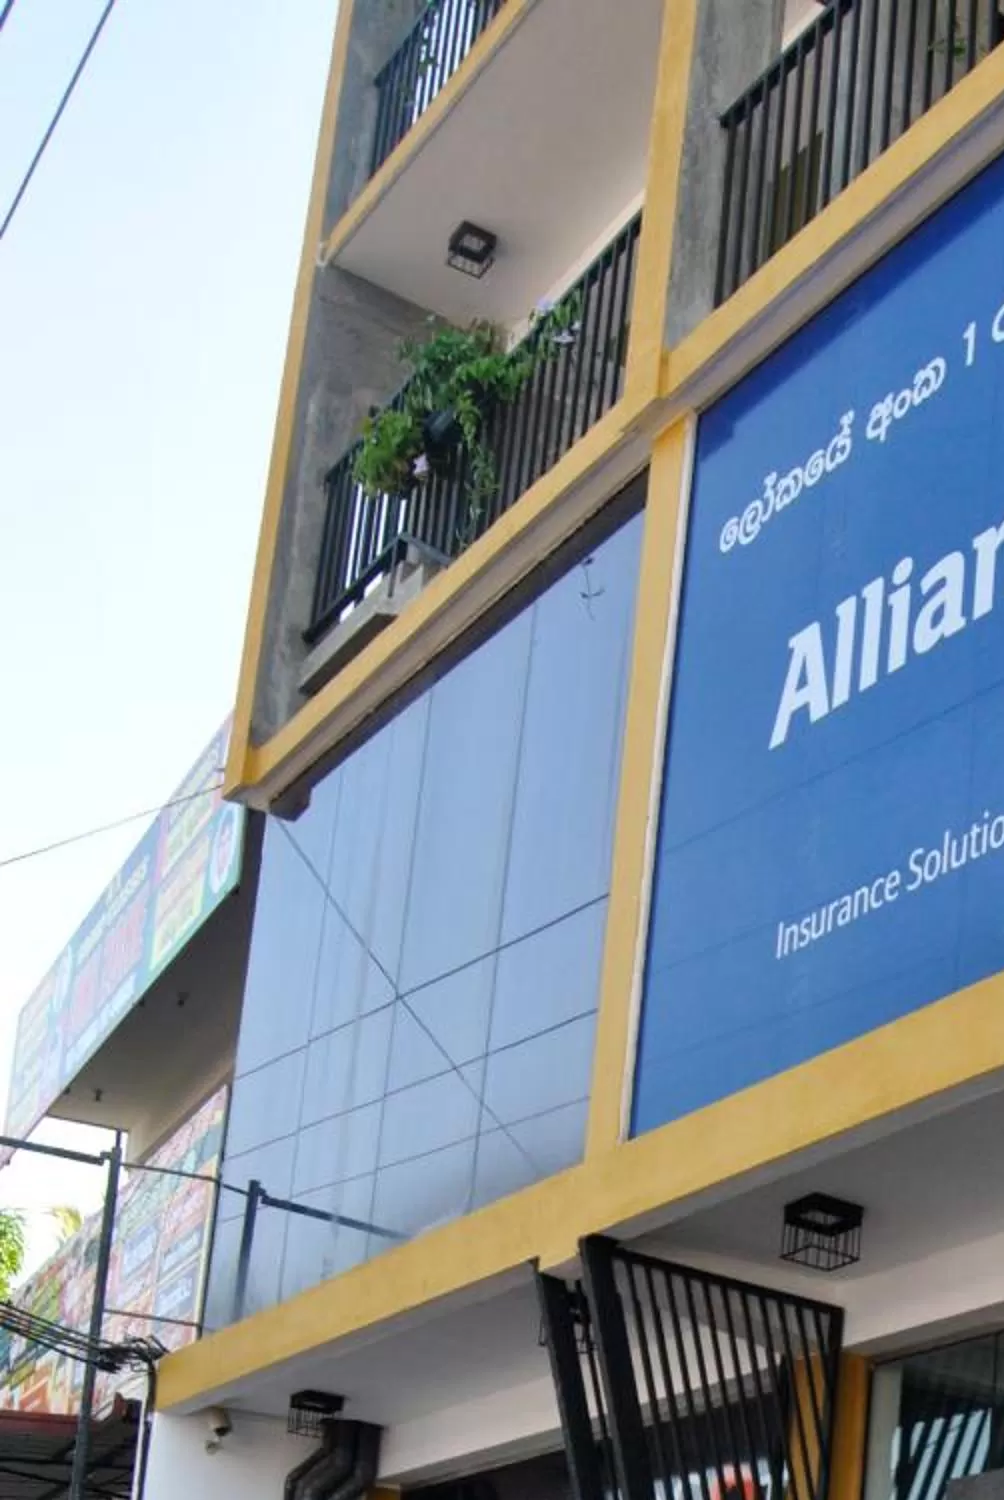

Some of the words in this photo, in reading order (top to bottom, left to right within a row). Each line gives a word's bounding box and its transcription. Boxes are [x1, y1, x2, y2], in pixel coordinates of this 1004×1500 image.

[719, 409, 855, 553] ලෝකයේ
[865, 361, 947, 442] අංක
[962, 321, 976, 367] 1
[774, 869, 900, 960] Insurance
